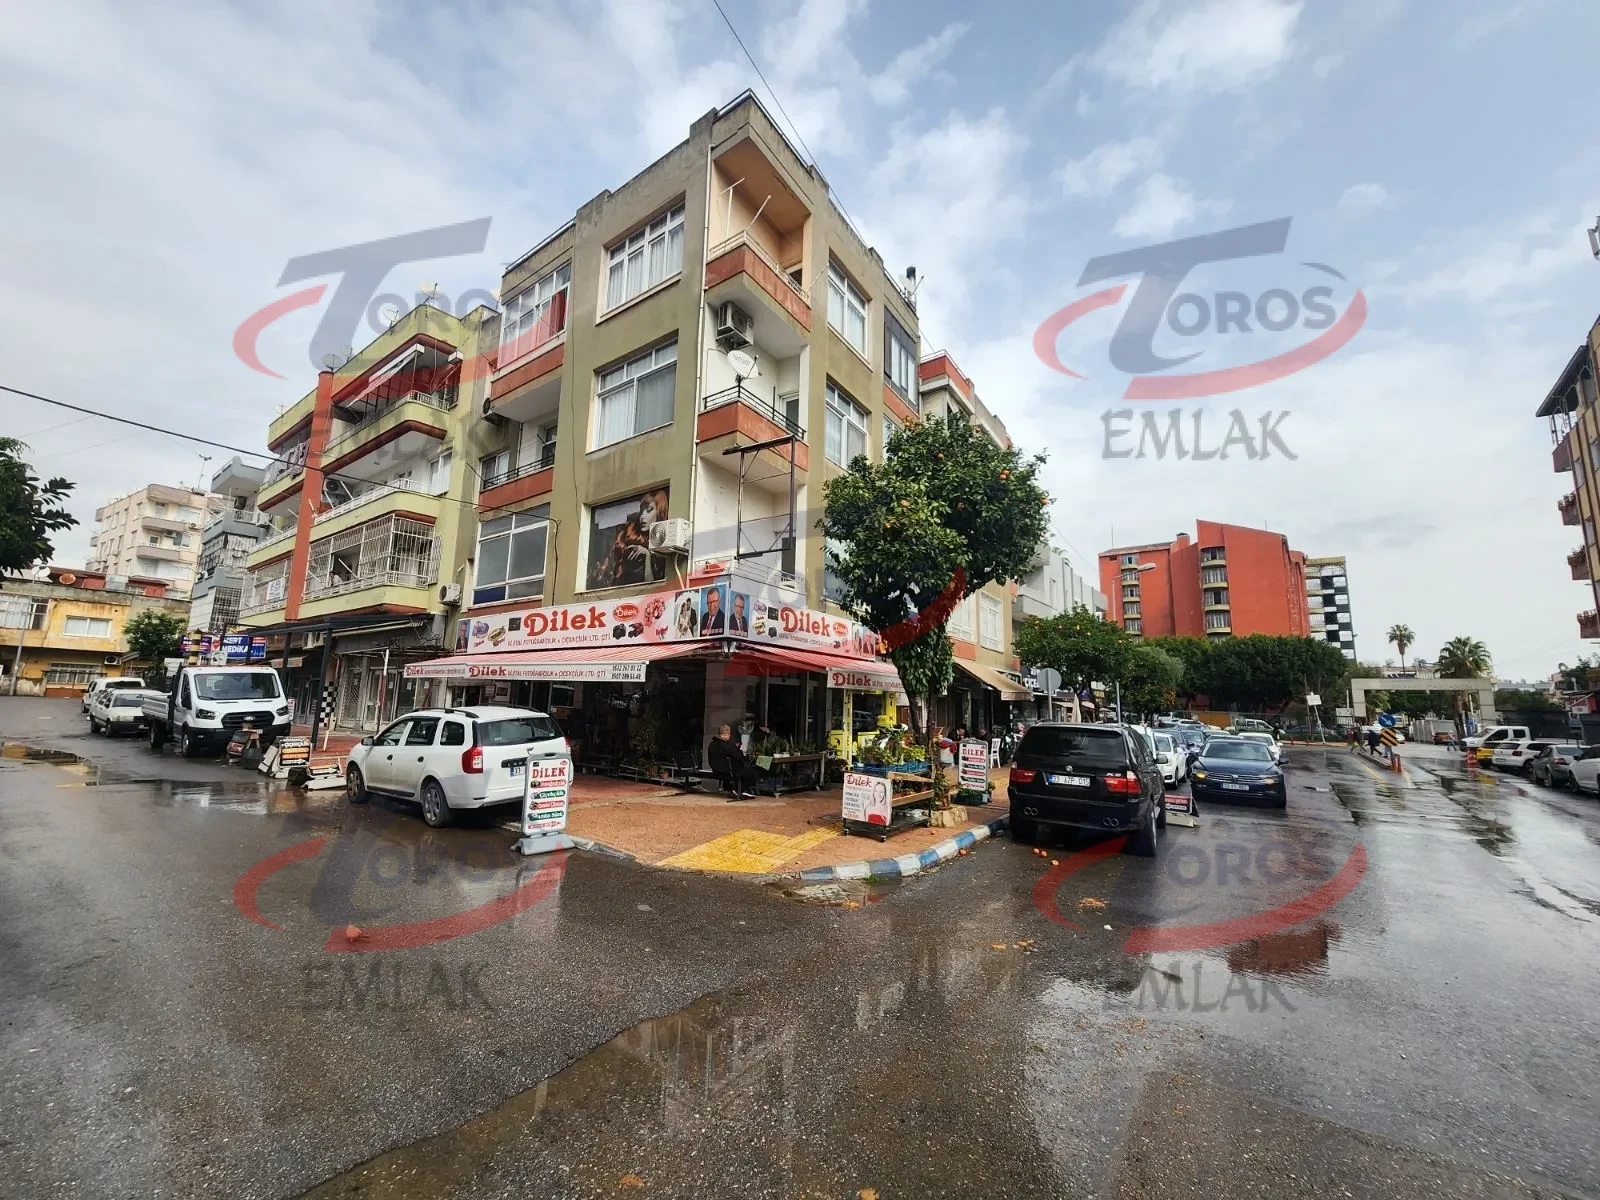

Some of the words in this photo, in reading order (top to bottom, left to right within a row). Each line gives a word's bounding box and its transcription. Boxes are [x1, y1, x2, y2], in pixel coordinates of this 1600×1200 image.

[616, 607, 637, 617] Dilek
[524, 606, 606, 637] Dilek
[780, 606, 831, 637] Dilek
[469, 665, 506, 677] Dilek
[832, 671, 871, 687] Dilek
[846, 773, 872, 787] Dilek
